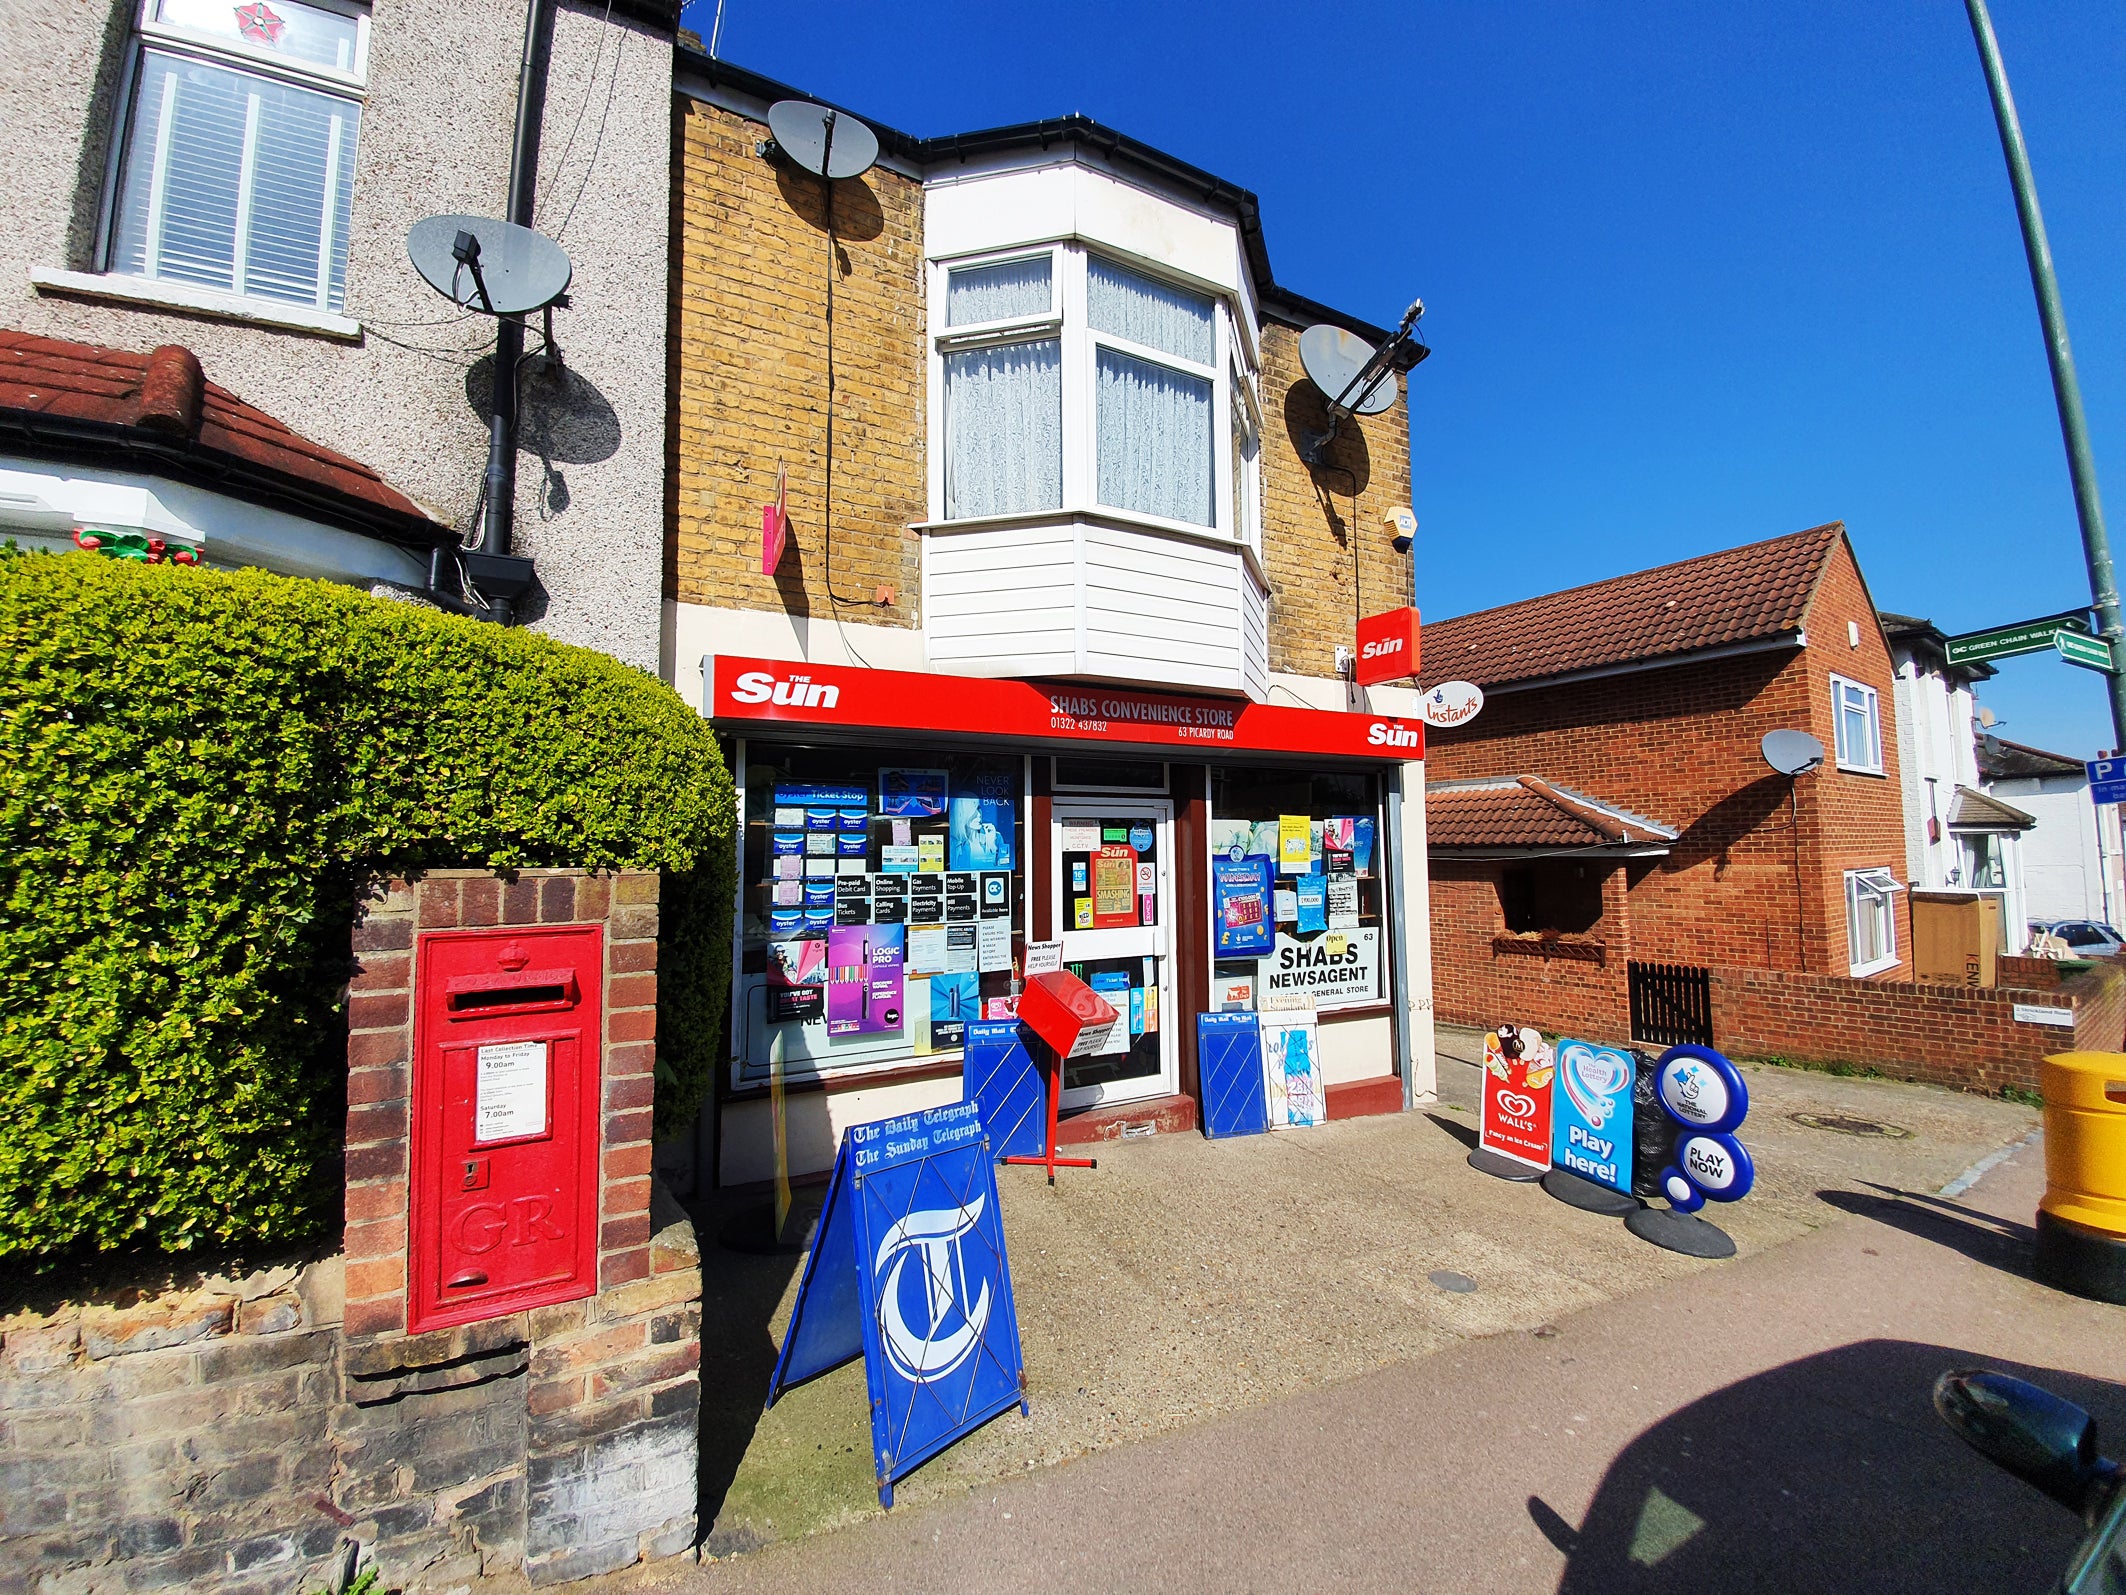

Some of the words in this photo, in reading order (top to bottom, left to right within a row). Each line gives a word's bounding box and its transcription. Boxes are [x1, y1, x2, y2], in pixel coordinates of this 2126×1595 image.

[1968, 640, 1998, 652] GREEN
[2000, 634, 2028, 645] CHAIN
[2030, 628, 2056, 640] WALK
[1362, 638, 1403, 660] Sun
[789, 674, 812, 683] THE
[731, 672, 840, 708] Sun
[1050, 695, 1097, 716] SHABS
[1102, 700, 1191, 724] CONVENIENCE
[1195, 708, 1232, 726] STORE
[1426, 696, 1478, 722] Instants
[1050, 716, 1076, 730] 01322
[1178, 726, 1187, 737] 63
[1189, 728, 1214, 739] PICARDY
[1217, 730, 1234, 740] ROAD
[1368, 723, 1418, 748] Sun
[2095, 762, 2112, 780] P
[977, 776, 1009, 785] NEVER
[812, 790, 840, 799] Ticket
[842, 790, 864, 801] Stop
[982, 786, 1008, 796] LOOK
[984, 796, 1009, 806] BACK
[1100, 848, 1128, 857] Sun
[1097, 890, 1130, 899] SMASHING
[1326, 935, 1343, 943] Open
[872, 947, 900, 956] LOGIC
[1280, 943, 1358, 969] SHABS
[1270, 966, 1367, 989] NEWSAGENT
[1312, 988, 1343, 997] GENERAL
[1346, 986, 1368, 994] STORE
[973, 1028, 990, 1036] Daily
[1092, 1027, 1112, 1035] Shopper
[486, 1061, 514, 1069] 9.00am
[1584, 1065, 1607, 1076] Health
[1582, 1070, 1607, 1084] Lottery
[485, 1110, 514, 1118] 7.00am
[1677, 1102, 1708, 1115] NATIONAL
[1679, 1108, 1706, 1119] LOTTERY
[854, 1126, 880, 1143] The
[885, 1117, 918, 1136] Daily
[924, 1100, 978, 1125] Telegraph
[1498, 1113, 1533, 1132] WALL'S
[856, 1149, 879, 1167] The
[885, 1137, 928, 1159] Sunday
[933, 1120, 981, 1144] Telegraph
[1524, 1140, 1544, 1151] Cream?
[1569, 1125, 1613, 1159] Play
[1690, 1147, 1724, 1167] PLAY
[1565, 1148, 1616, 1183] here!
[1690, 1159, 1723, 1179] NOW
